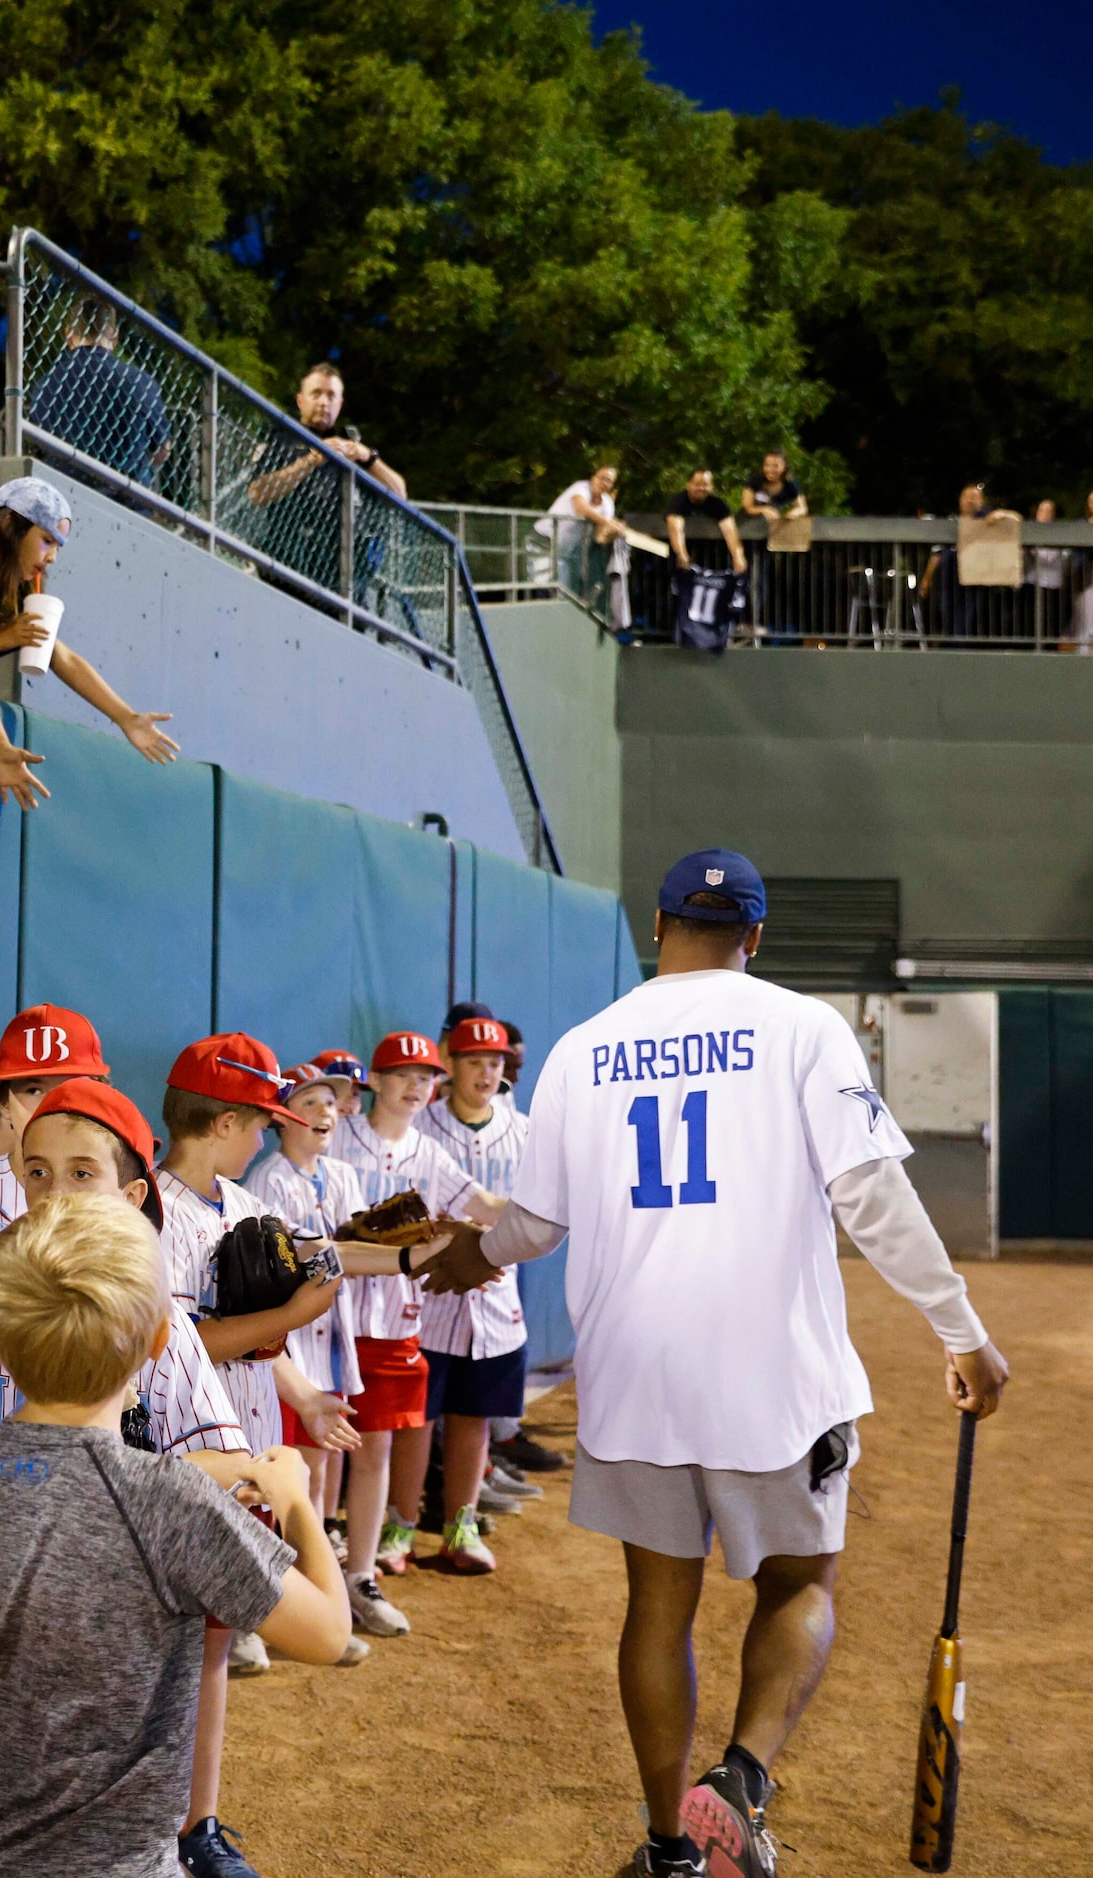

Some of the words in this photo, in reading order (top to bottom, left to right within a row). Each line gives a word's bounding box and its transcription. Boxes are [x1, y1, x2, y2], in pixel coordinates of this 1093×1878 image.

[688, 585, 720, 626] 11
[23, 1025, 70, 1062] UB
[592, 1029, 755, 1087] PARSONS
[627, 1090, 717, 1209] 11
